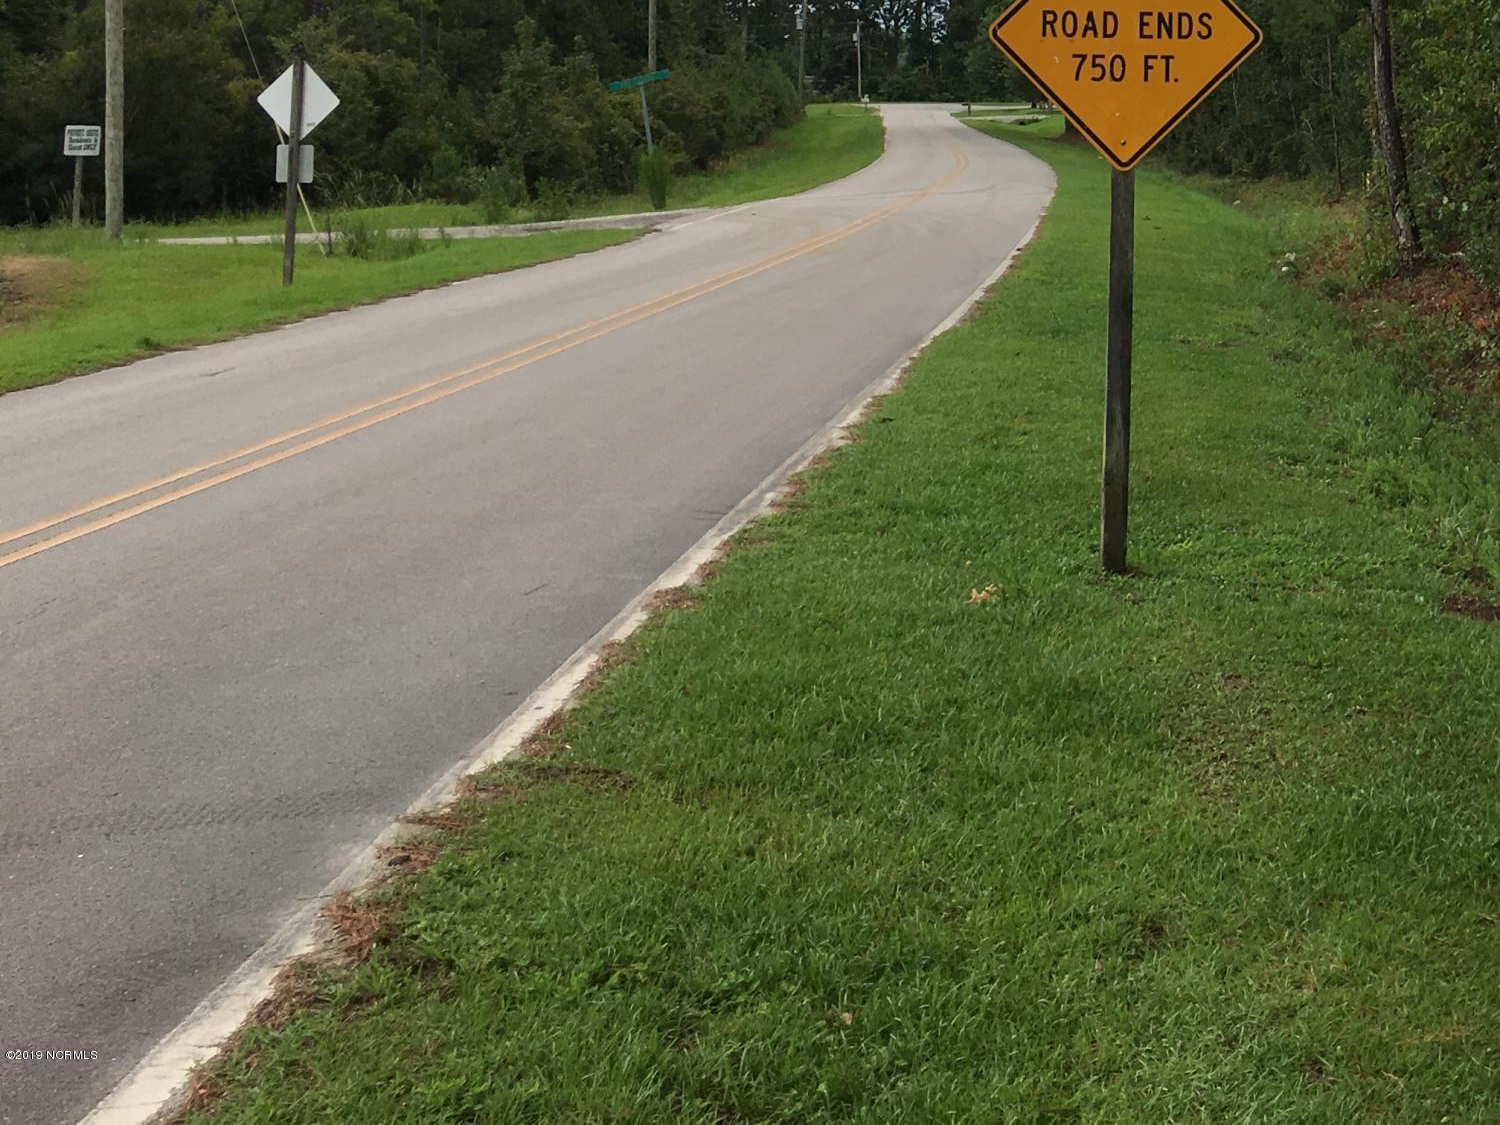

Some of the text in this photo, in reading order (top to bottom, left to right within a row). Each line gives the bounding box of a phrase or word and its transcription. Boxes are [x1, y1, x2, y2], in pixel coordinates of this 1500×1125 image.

[1041, 10, 1213, 40] ROAD ENDS
[1072, 53, 1179, 83] 750 FT.
